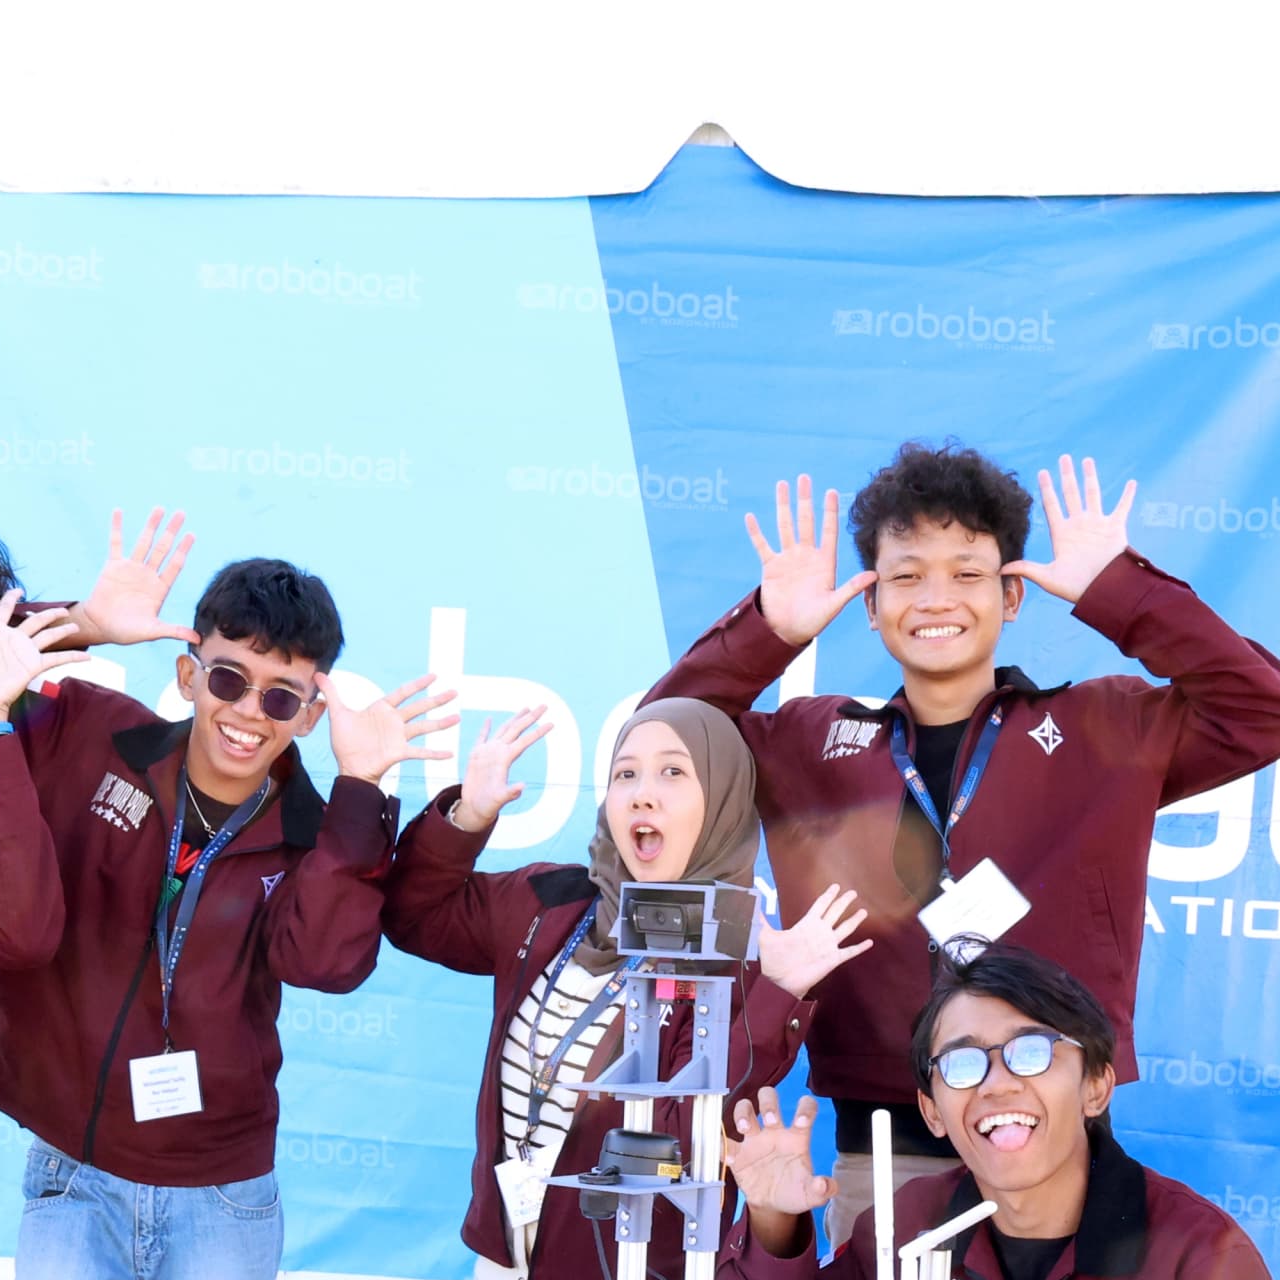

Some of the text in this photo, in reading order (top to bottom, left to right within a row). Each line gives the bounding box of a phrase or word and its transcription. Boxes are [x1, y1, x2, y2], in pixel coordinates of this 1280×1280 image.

[240, 256, 424, 302] roboboat
[559, 277, 739, 321] roboboat
[874, 303, 1056, 345] roboboat
[231, 440, 414, 484] roboboat
[549, 460, 728, 504] roboboat
